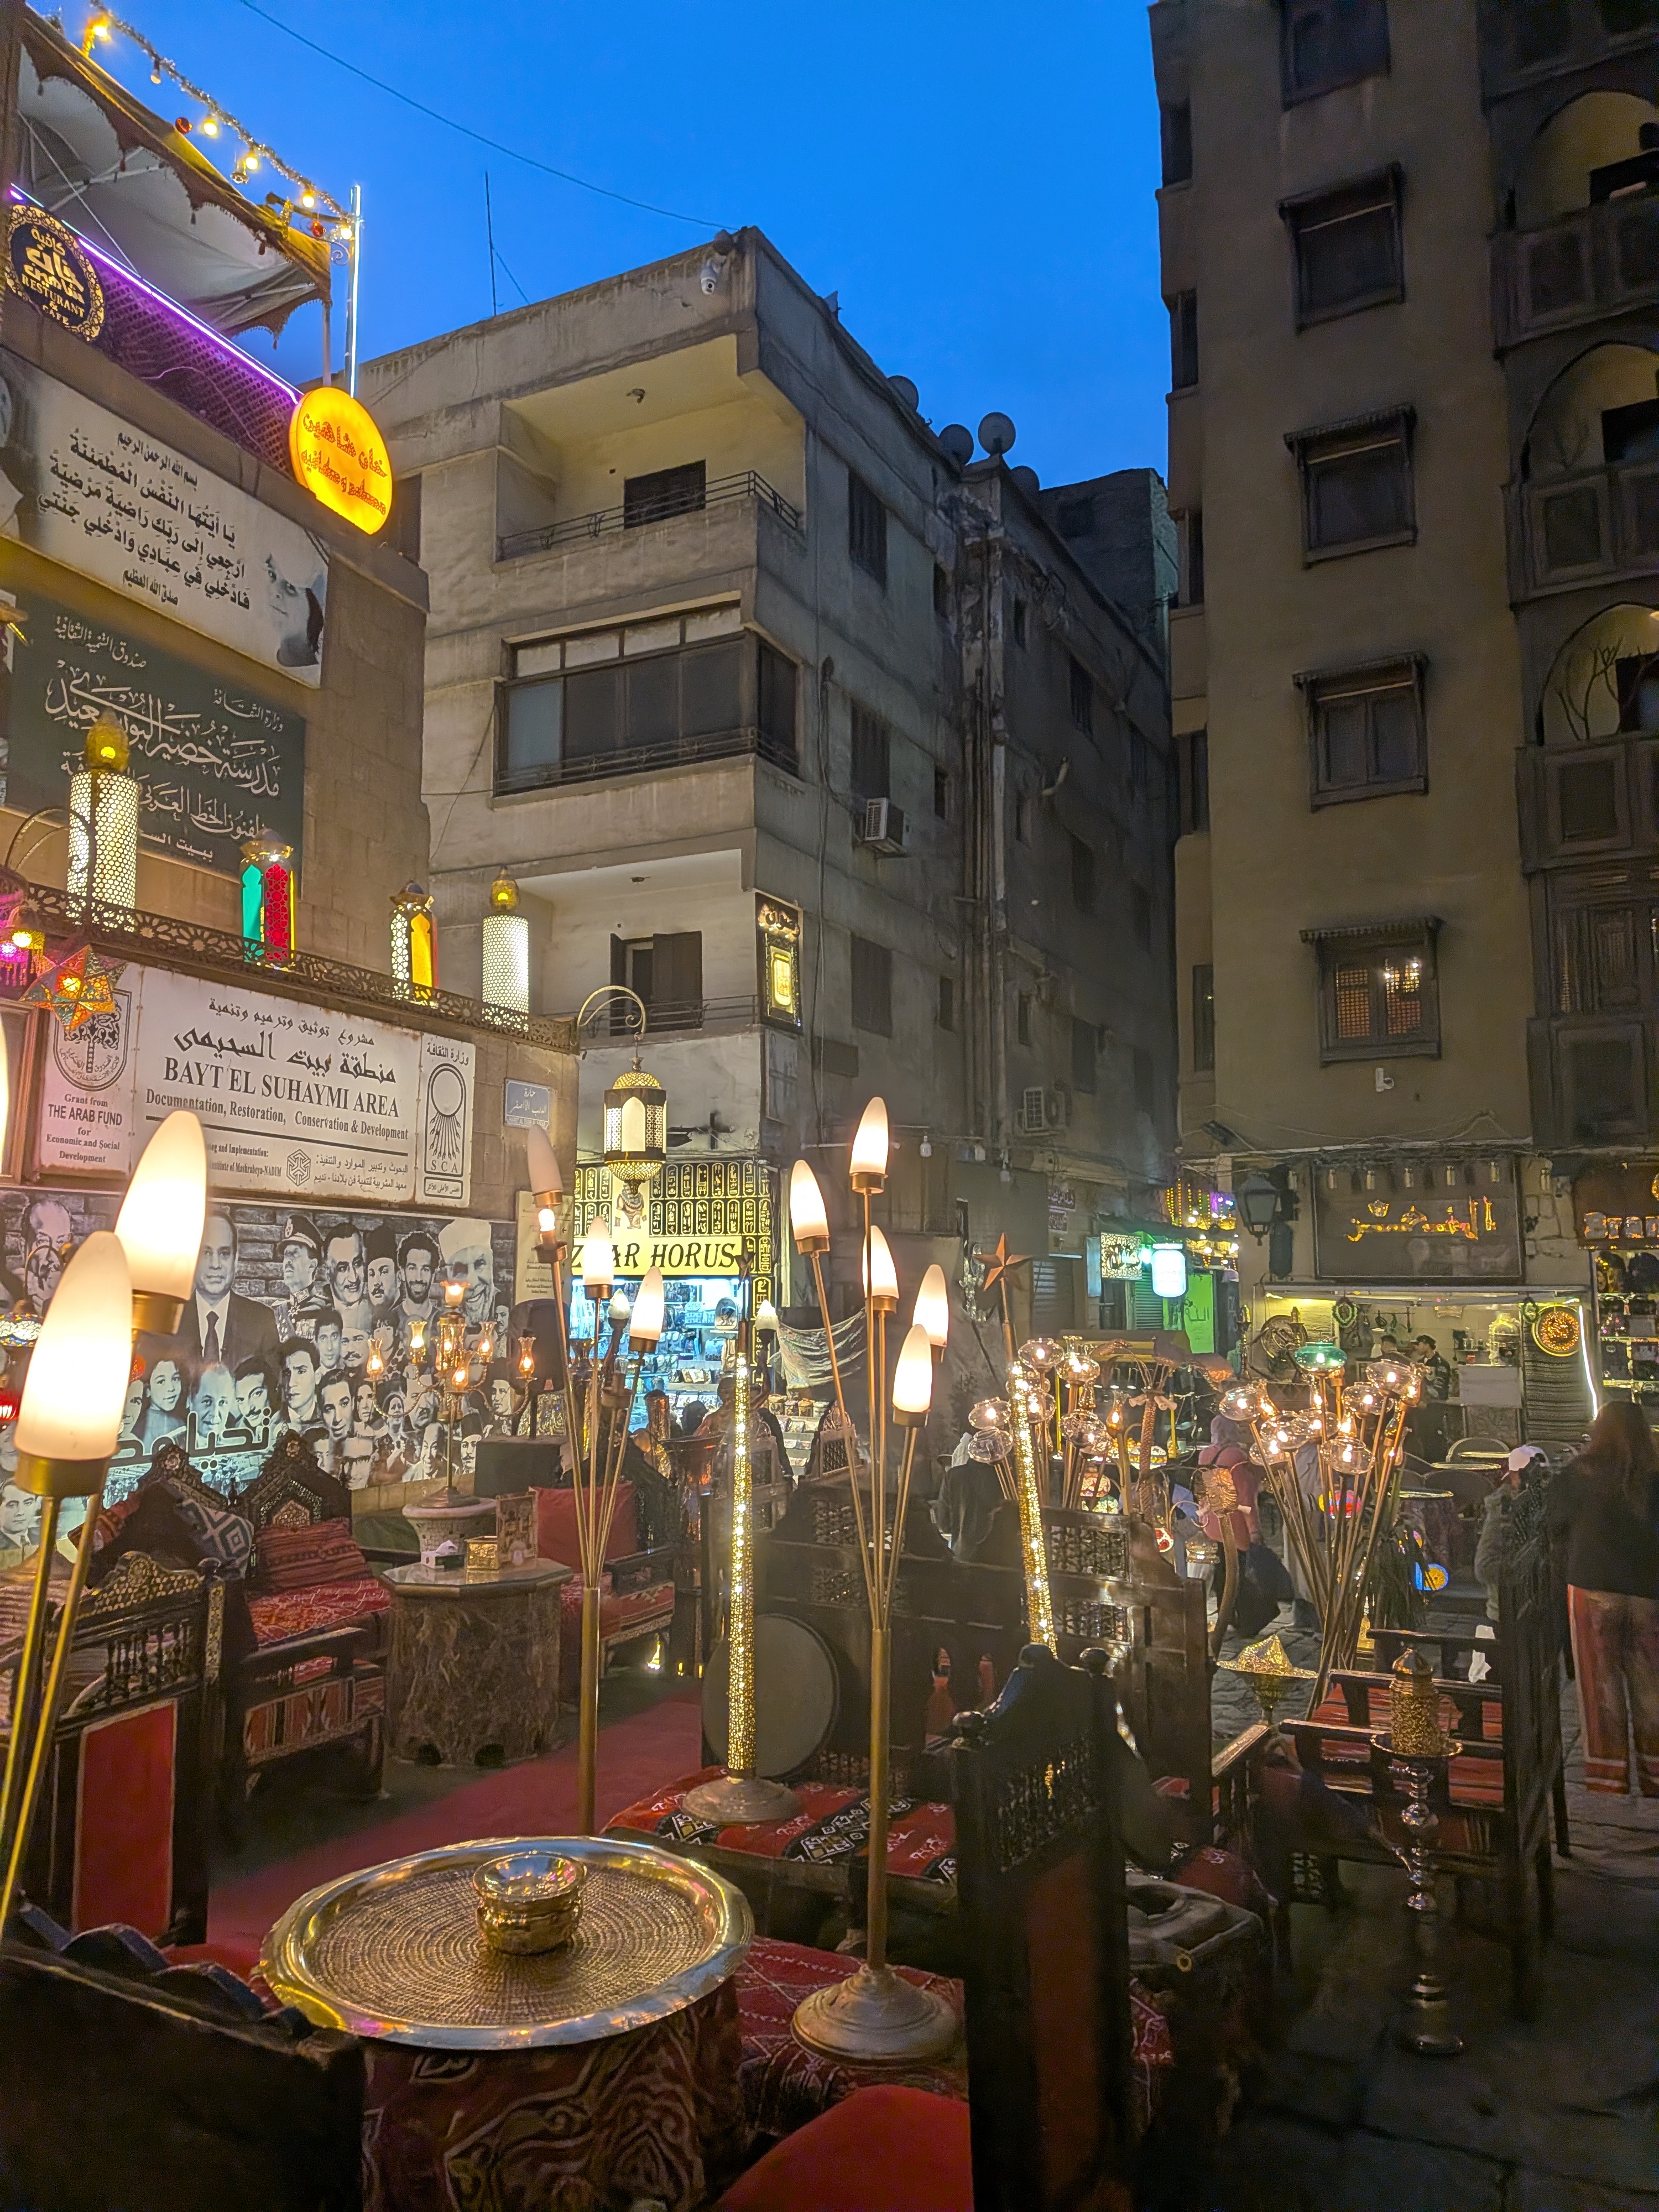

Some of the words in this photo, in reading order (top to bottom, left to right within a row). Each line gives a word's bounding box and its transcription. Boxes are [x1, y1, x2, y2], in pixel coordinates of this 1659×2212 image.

[21, 273, 85, 318] RESTURANT
[49, 300, 58, 311] &
[43, 305, 70, 326] CAFE
[303, 413, 357, 458] شاهين
[171, 461, 183, 477] الله
[358, 448, 387, 478] خان
[112, 641, 146, 667] صندوق
[208, 998, 249, 1022] وتنمية
[298, 1020, 330, 1038] توثيق
[337, 1029, 374, 1046] مشروع
[427, 1042, 448, 1057] الثقافة
[450, 1048, 469, 1066] وزارة
[286, 1050, 332, 1078] بيت
[340, 1052, 397, 1084] منطقة
[163, 1057, 223, 1088] BAYT
[228, 1068, 256, 1094] EL
[261, 1074, 349, 1110] SUHAYMI
[353, 1092, 399, 1118] AREA
[65, 1093, 88, 1104] Grant
[90, 1097, 108, 1107] from
[48, 1104, 66, 1119] THE
[69, 1107, 95, 1122] ARAB
[98, 1111, 122, 1125] FUND
[146, 1088, 226, 1117] Documentation,
[229, 1101, 286, 1125] Restoration,
[295, 1110, 348, 1131] Conservation
[351, 1120, 358, 1133] &
[361, 1121, 408, 1141] Development
[77, 1127, 91, 1135] for
[46, 1134, 82, 1145] Economic
[99, 1140, 120, 1150] Social
[218, 1144, 227, 1152] and
[229, 1144, 269, 1157] Implementation:
[59, 1151, 106, 1163] Development
[649, 1242, 736, 1269] HORUS
[186, 1406, 272, 1470] تحيا
